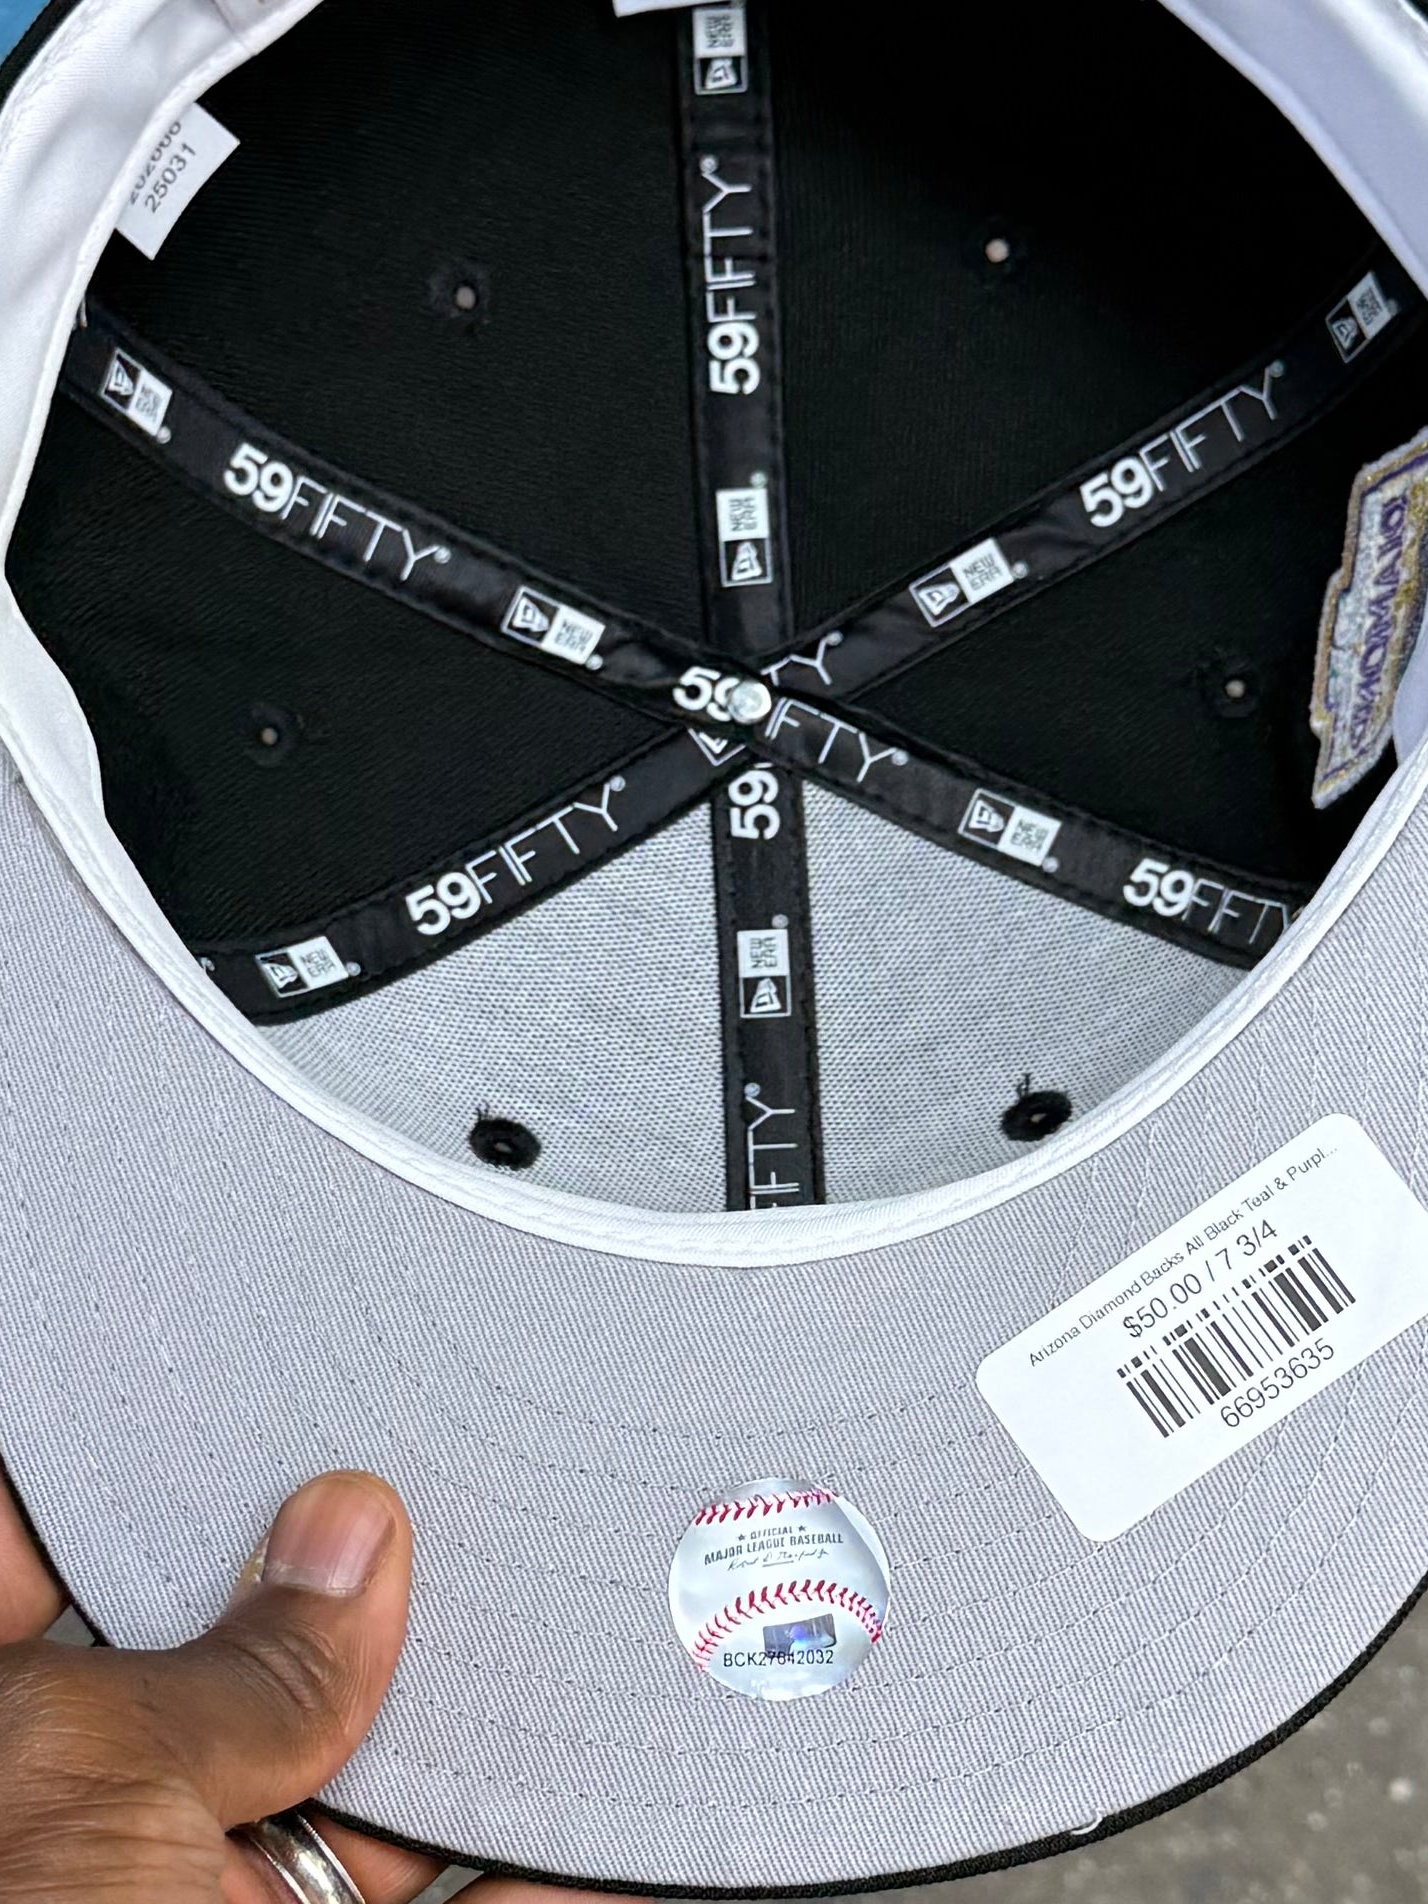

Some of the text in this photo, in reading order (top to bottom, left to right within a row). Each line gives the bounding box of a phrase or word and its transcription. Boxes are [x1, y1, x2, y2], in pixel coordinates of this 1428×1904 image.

[144, 142, 197, 213] 25031
[701, 169, 761, 396] 59FIFTY
[1080, 365, 1278, 527] 59FIFTY
[223, 442, 440, 582] 59FIFTY
[962, 553, 996, 579] NEW
[404, 783, 619, 936] 59FIFTY
[1028, 1325, 1081, 1367] Arizona
[1078, 1280, 1142, 1329] Diamond
[1140, 1252, 1185, 1286] Backs
[1184, 1234, 1205, 1255] All
[1204, 1208, 1244, 1241] Black
[1241, 1182, 1275, 1213] Teal
[1274, 1174, 1288, 1191] &
[1122, 1272, 1203, 1339] $50.00
[1216, 1248, 1234, 1272] 7
[1236, 1218, 1278, 1259] 3/4
[1220, 1338, 1336, 1429] 66953635
[704, 1545, 743, 1566] MAJOR
[746, 1539, 786, 1554] LEAGUE
[789, 1532, 844, 1546] BASEBALL
[750, 1525, 793, 1540] OFFICIAL
